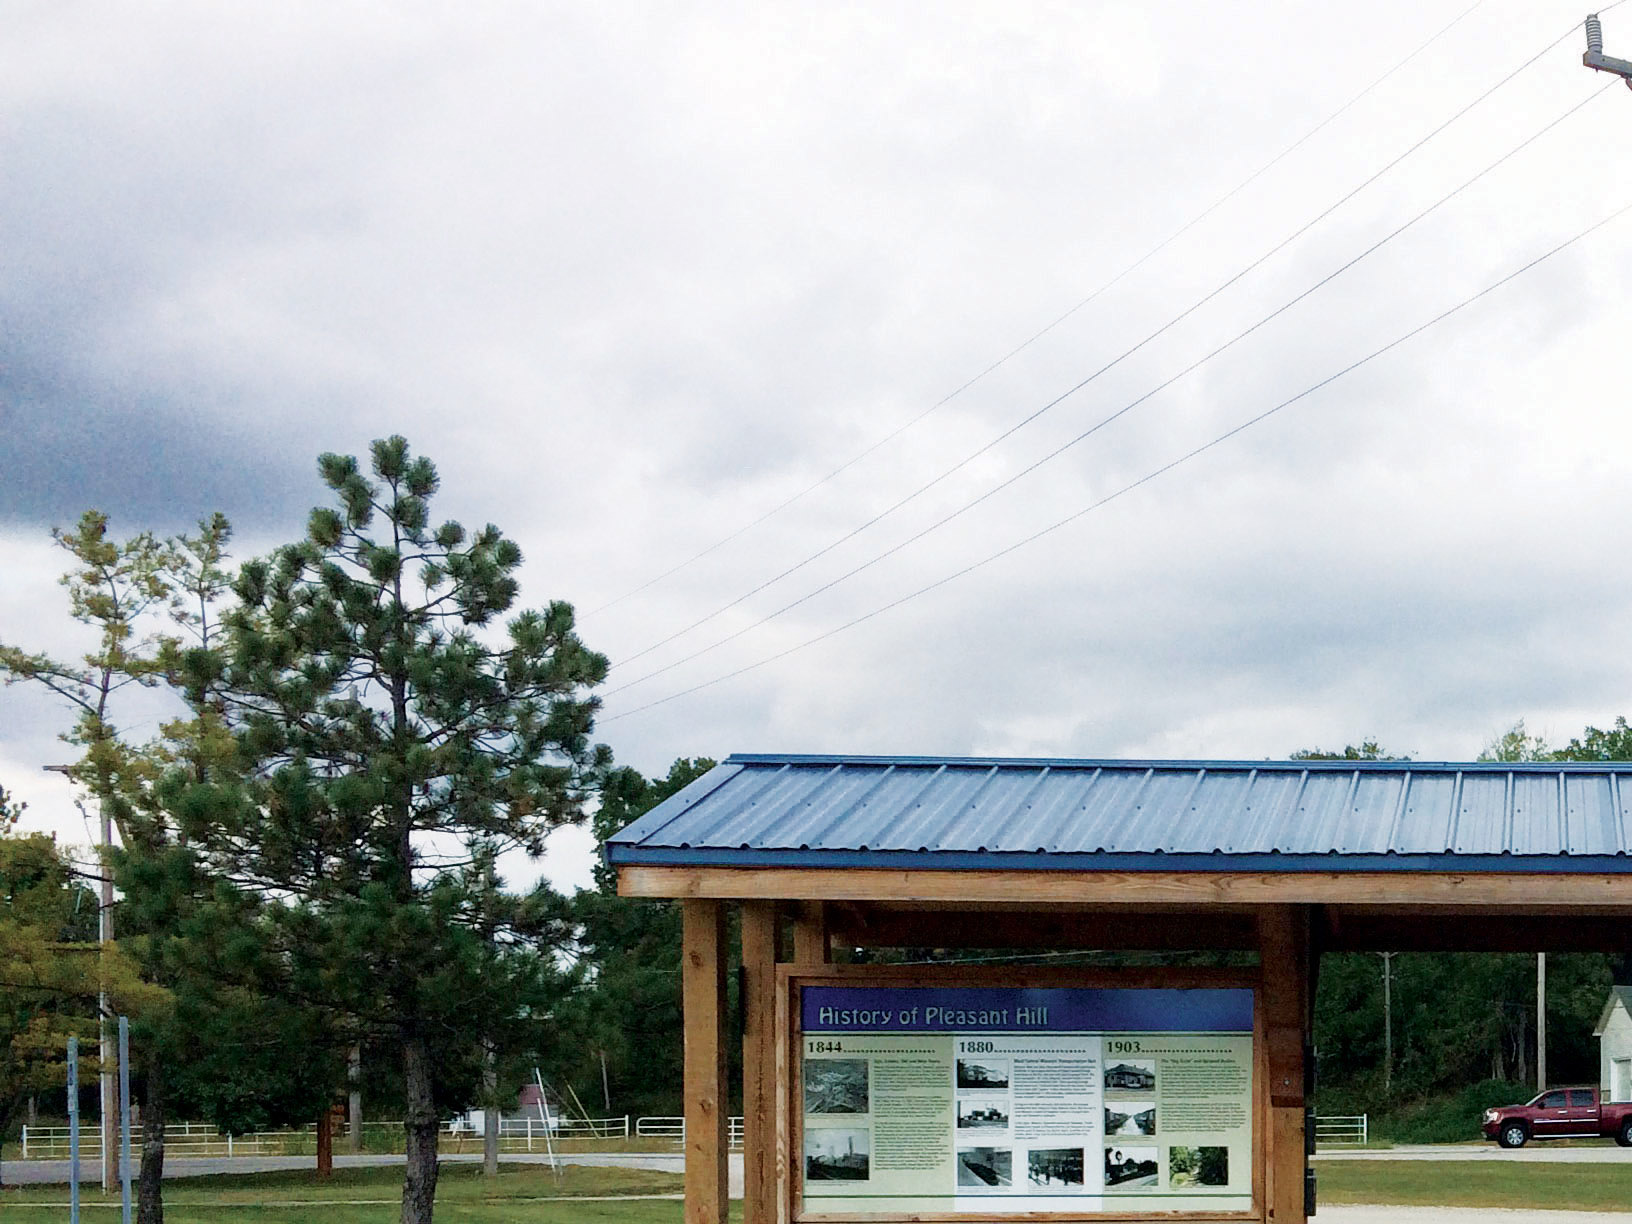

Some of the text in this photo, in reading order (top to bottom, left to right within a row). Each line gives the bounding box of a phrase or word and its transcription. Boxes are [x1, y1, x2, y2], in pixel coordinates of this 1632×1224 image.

[819, 1007, 1048, 1025] History of Pleasant Hill
[808, 1041, 843, 1053] 1844
[959, 1041, 993, 1053] 1880
[1107, 1041, 1141, 1053] 1903
